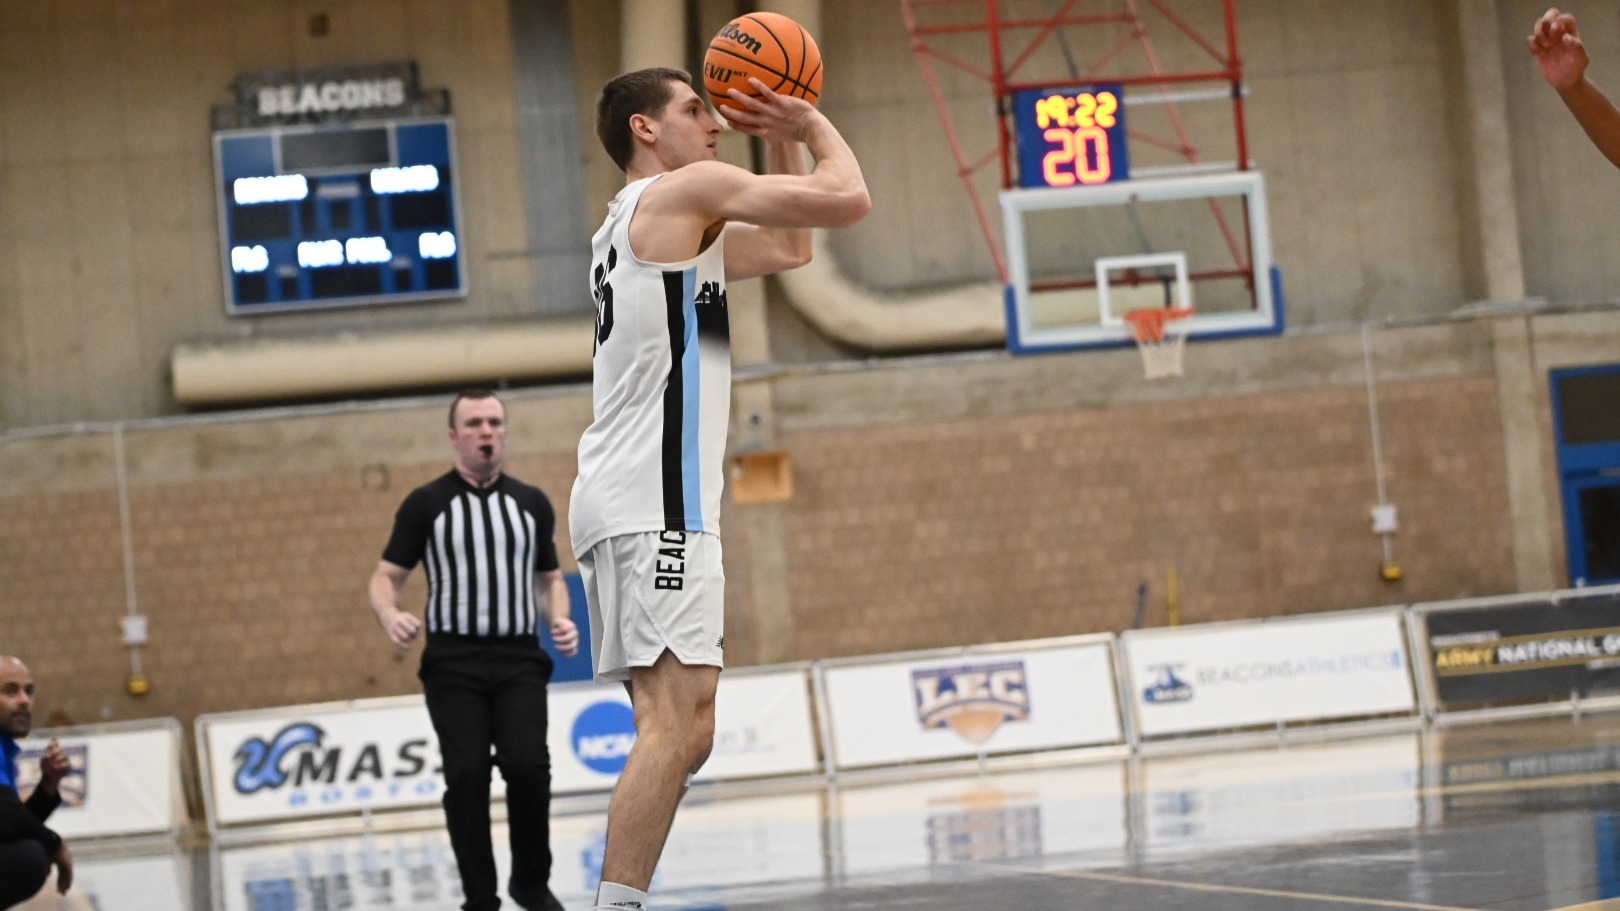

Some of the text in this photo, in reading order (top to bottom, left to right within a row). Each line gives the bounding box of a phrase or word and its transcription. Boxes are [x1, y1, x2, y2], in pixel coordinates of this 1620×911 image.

[257, 77, 405, 117] BEACONS
[1036, 91, 1117, 129] 19:22
[1043, 126, 1111, 187] 20
[1436, 646, 1495, 668] ARMY
[1498, 636, 1600, 665] NATIONAL
[1602, 633, 1620, 655] G
[915, 667, 1030, 718] LEC
